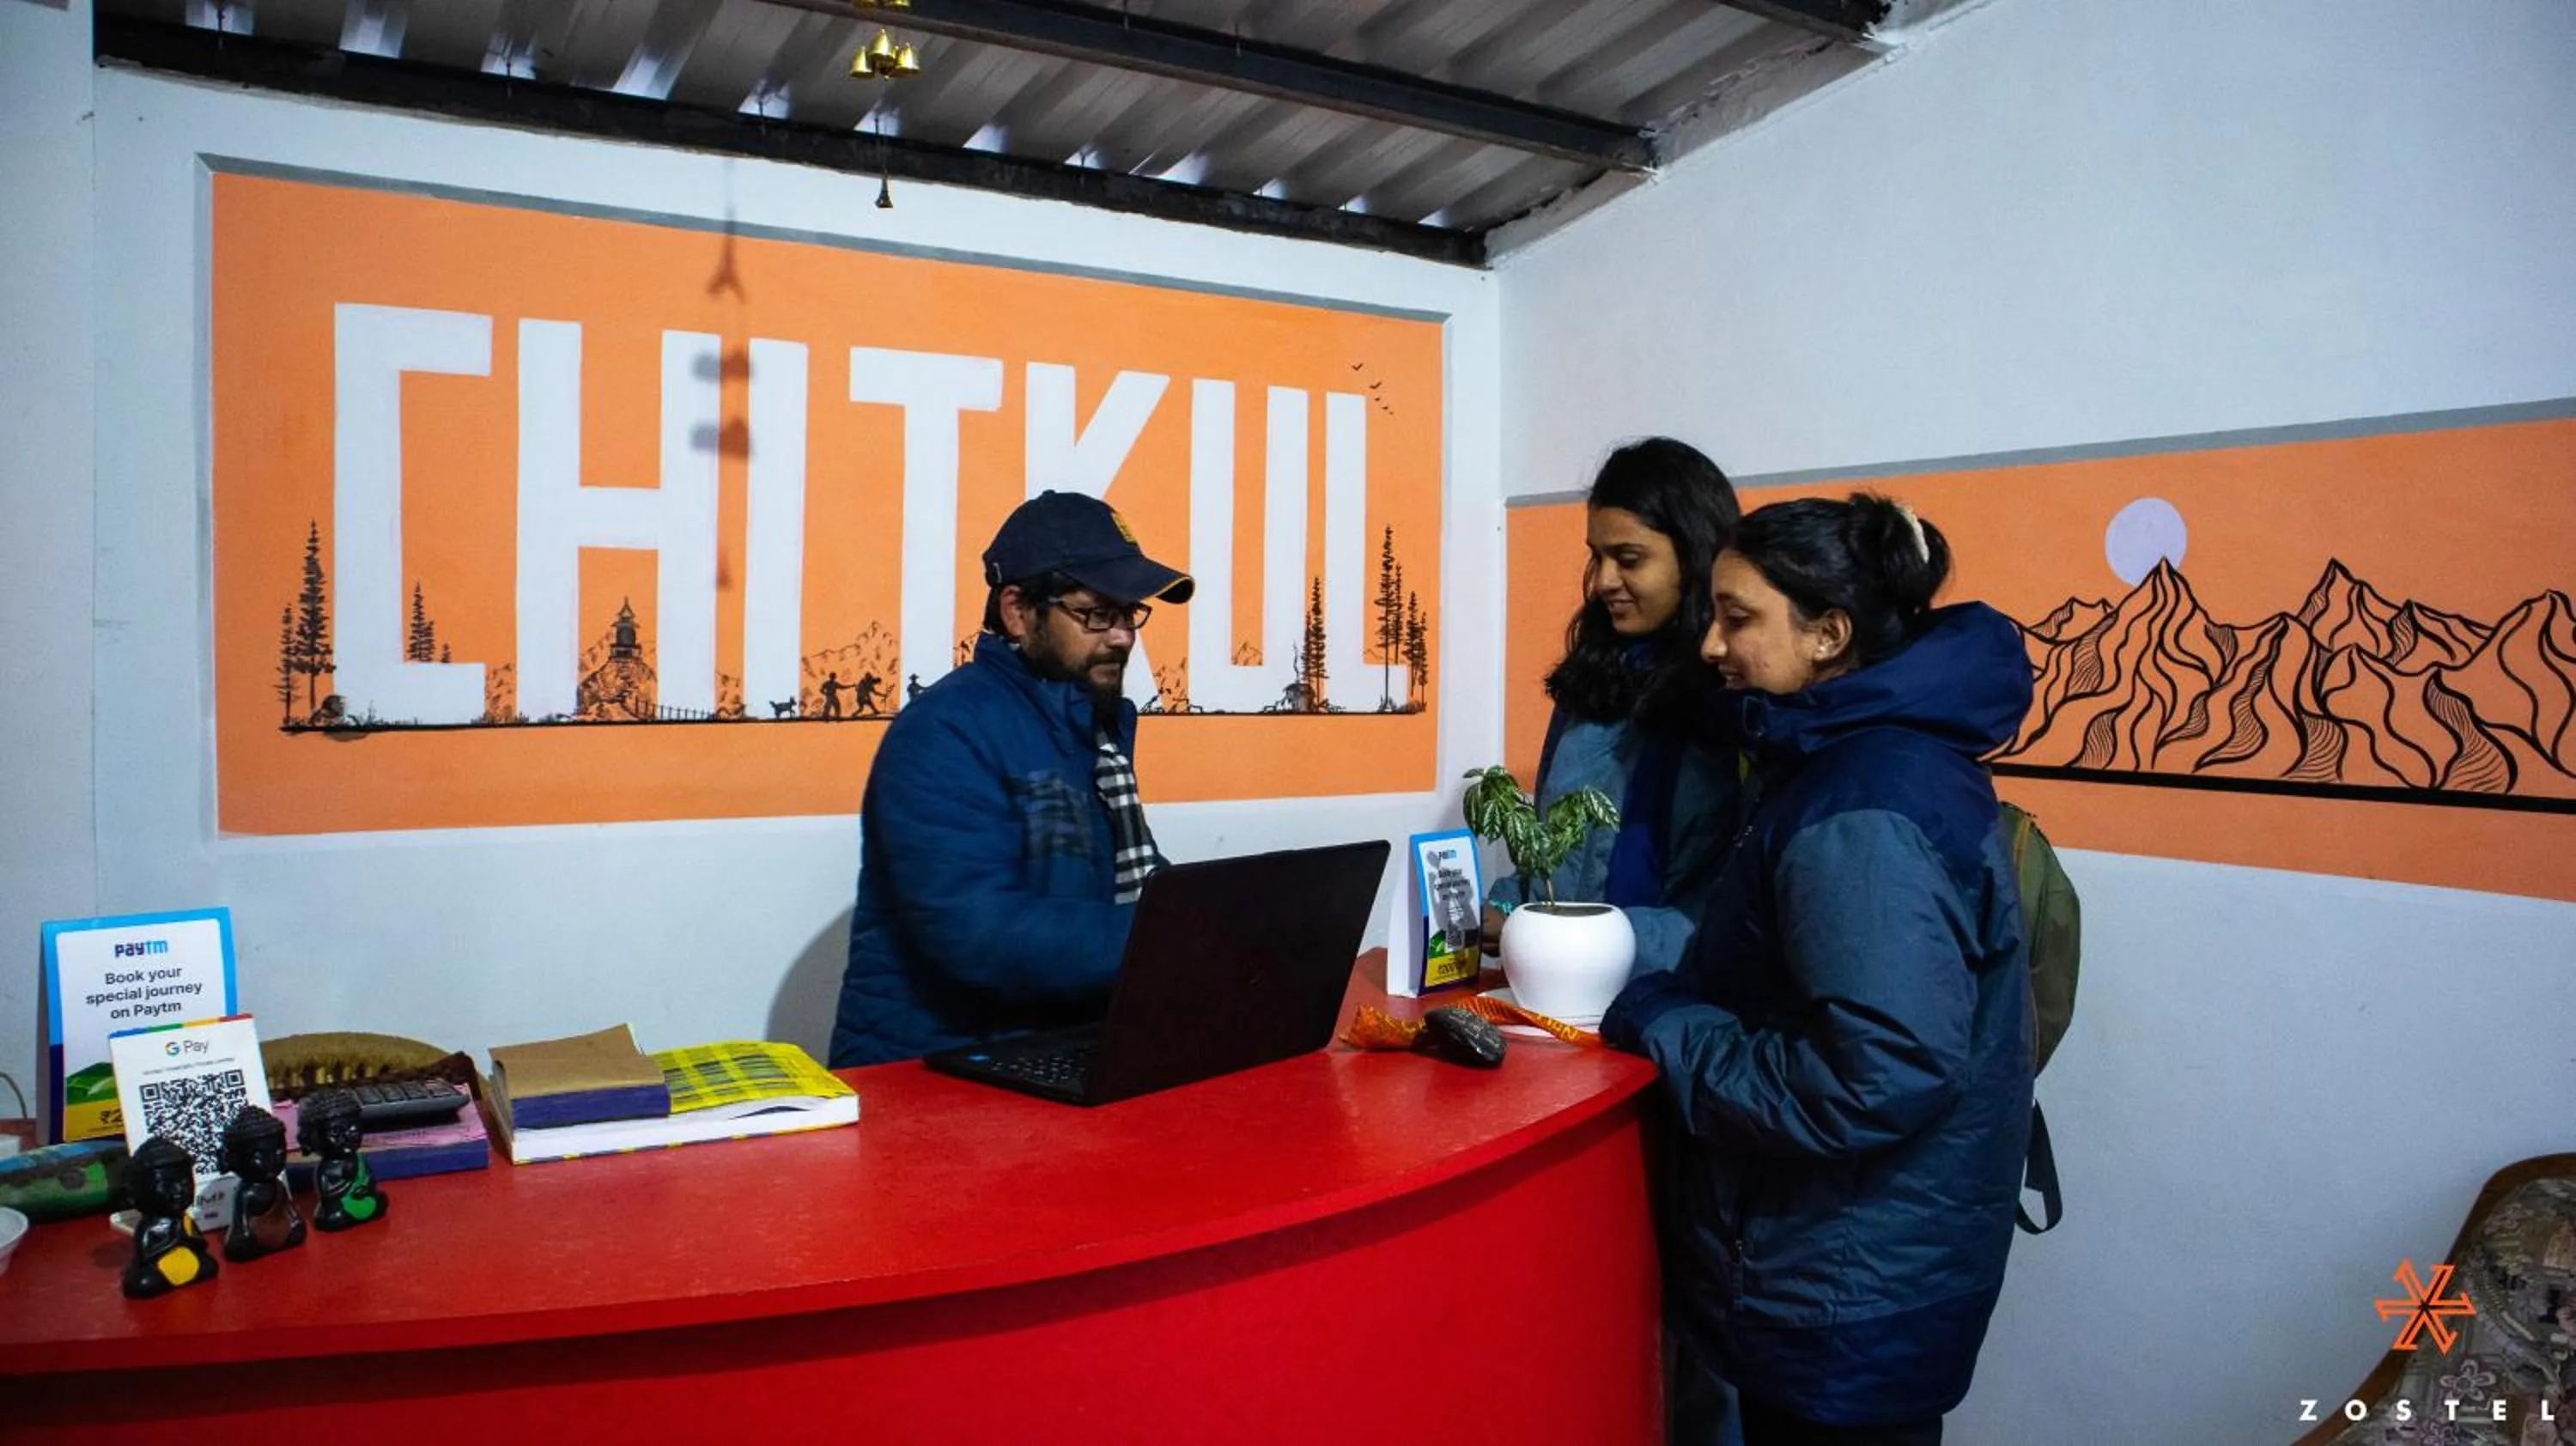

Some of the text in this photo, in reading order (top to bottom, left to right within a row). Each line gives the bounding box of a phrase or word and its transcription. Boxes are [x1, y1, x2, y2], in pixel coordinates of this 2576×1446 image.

[105, 968, 182, 985] Book your
[86, 981, 203, 1006] special journey
[110, 1001, 182, 1019] on Paytm
[184, 1039, 210, 1054] Pay
